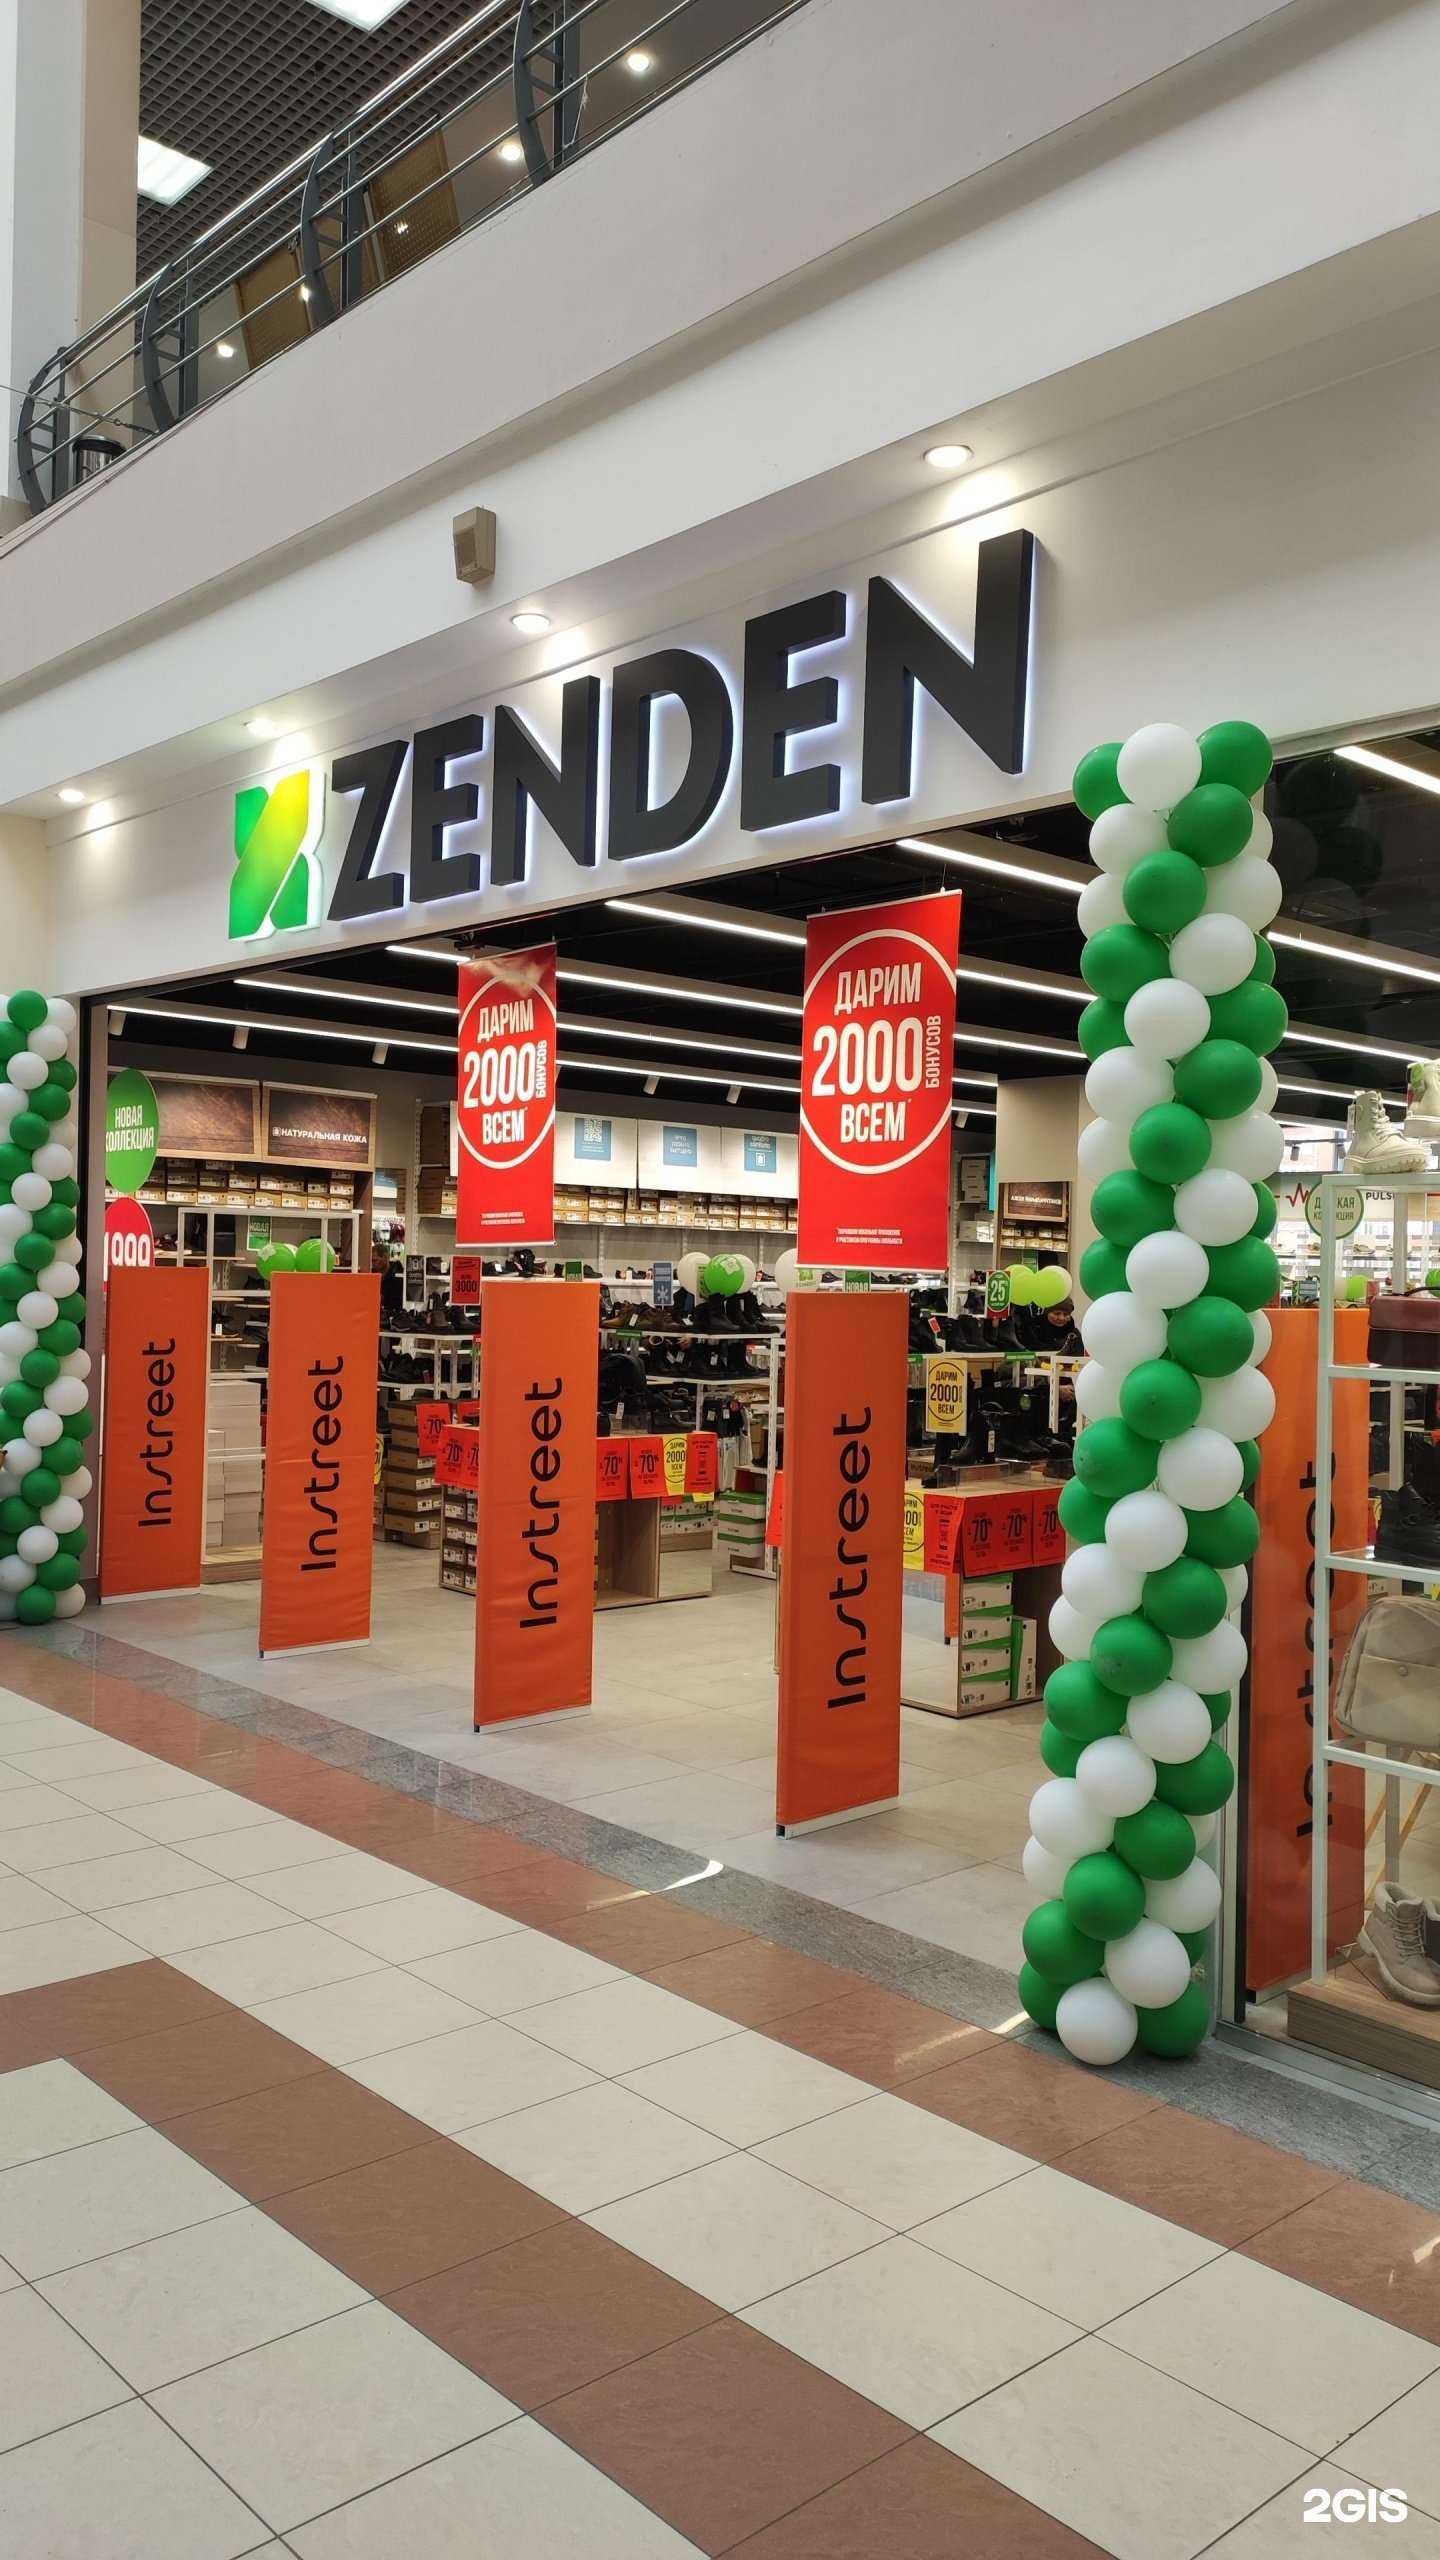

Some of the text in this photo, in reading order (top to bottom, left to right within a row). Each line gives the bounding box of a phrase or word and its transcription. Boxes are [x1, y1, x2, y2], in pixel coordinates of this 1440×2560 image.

[328, 528, 1034, 922] ZENDEN
[833, 962, 922, 1015] ДАРИМ
[476, 999, 534, 1043] ДАРИМ
[463, 1042, 536, 1109] 2000
[536, 1040, 547, 1099] БОНУСОВ
[811, 1017, 922, 1097] 2000
[925, 1015, 941, 1089] БОНУСОВ
[115, 1104, 143, 1129] НОВАЯ
[281, 1128, 368, 1144] НАТУРАЛЬНАЯ КОЖА
[1313, 1197, 1355, 1209] ДКАЯ
[1365, 1191, 1396, 1201] PULS
[455, 1280, 477, 1293] 3000
[930, 1383, 959, 1403] 2000
[935, 1370, 958, 1382] ДАРИМ
[139, 1337, 176, 1527] Instreet
[937, 1403, 955, 1415] ВСЕМ
[300, 1356, 344, 1572] Instreet
[665, 1450, 686, 1463] 2000
[520, 1377, 563, 1629] Instreet
[827, 1406, 872, 1710] Instreet
